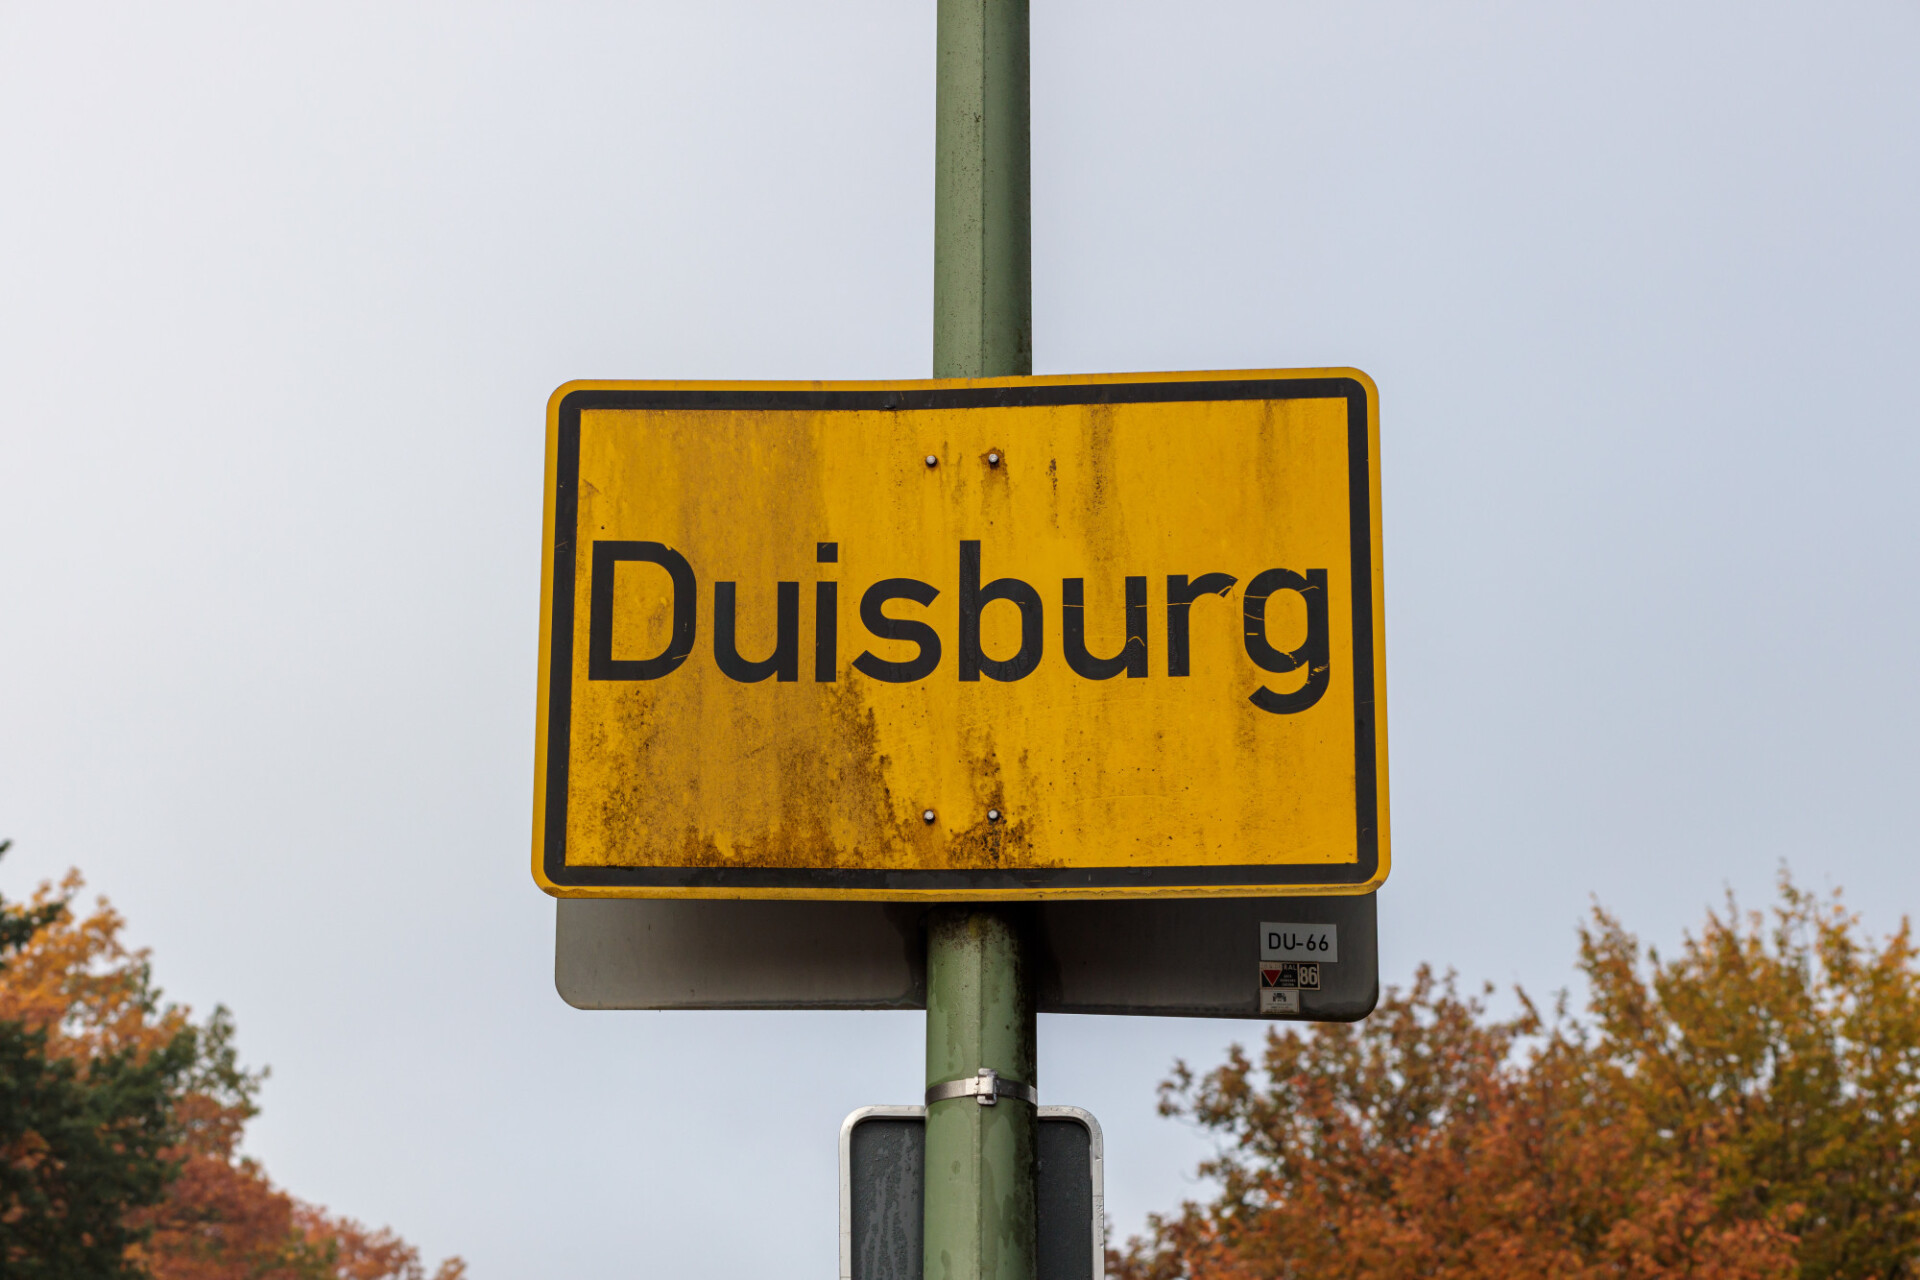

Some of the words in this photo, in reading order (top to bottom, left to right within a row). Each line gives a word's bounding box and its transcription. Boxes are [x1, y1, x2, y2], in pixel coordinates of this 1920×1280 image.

[589, 540, 1329, 715] Duisburg
[1268, 932, 1329, 952] DU-66
[1299, 966, 1318, 985] 86
